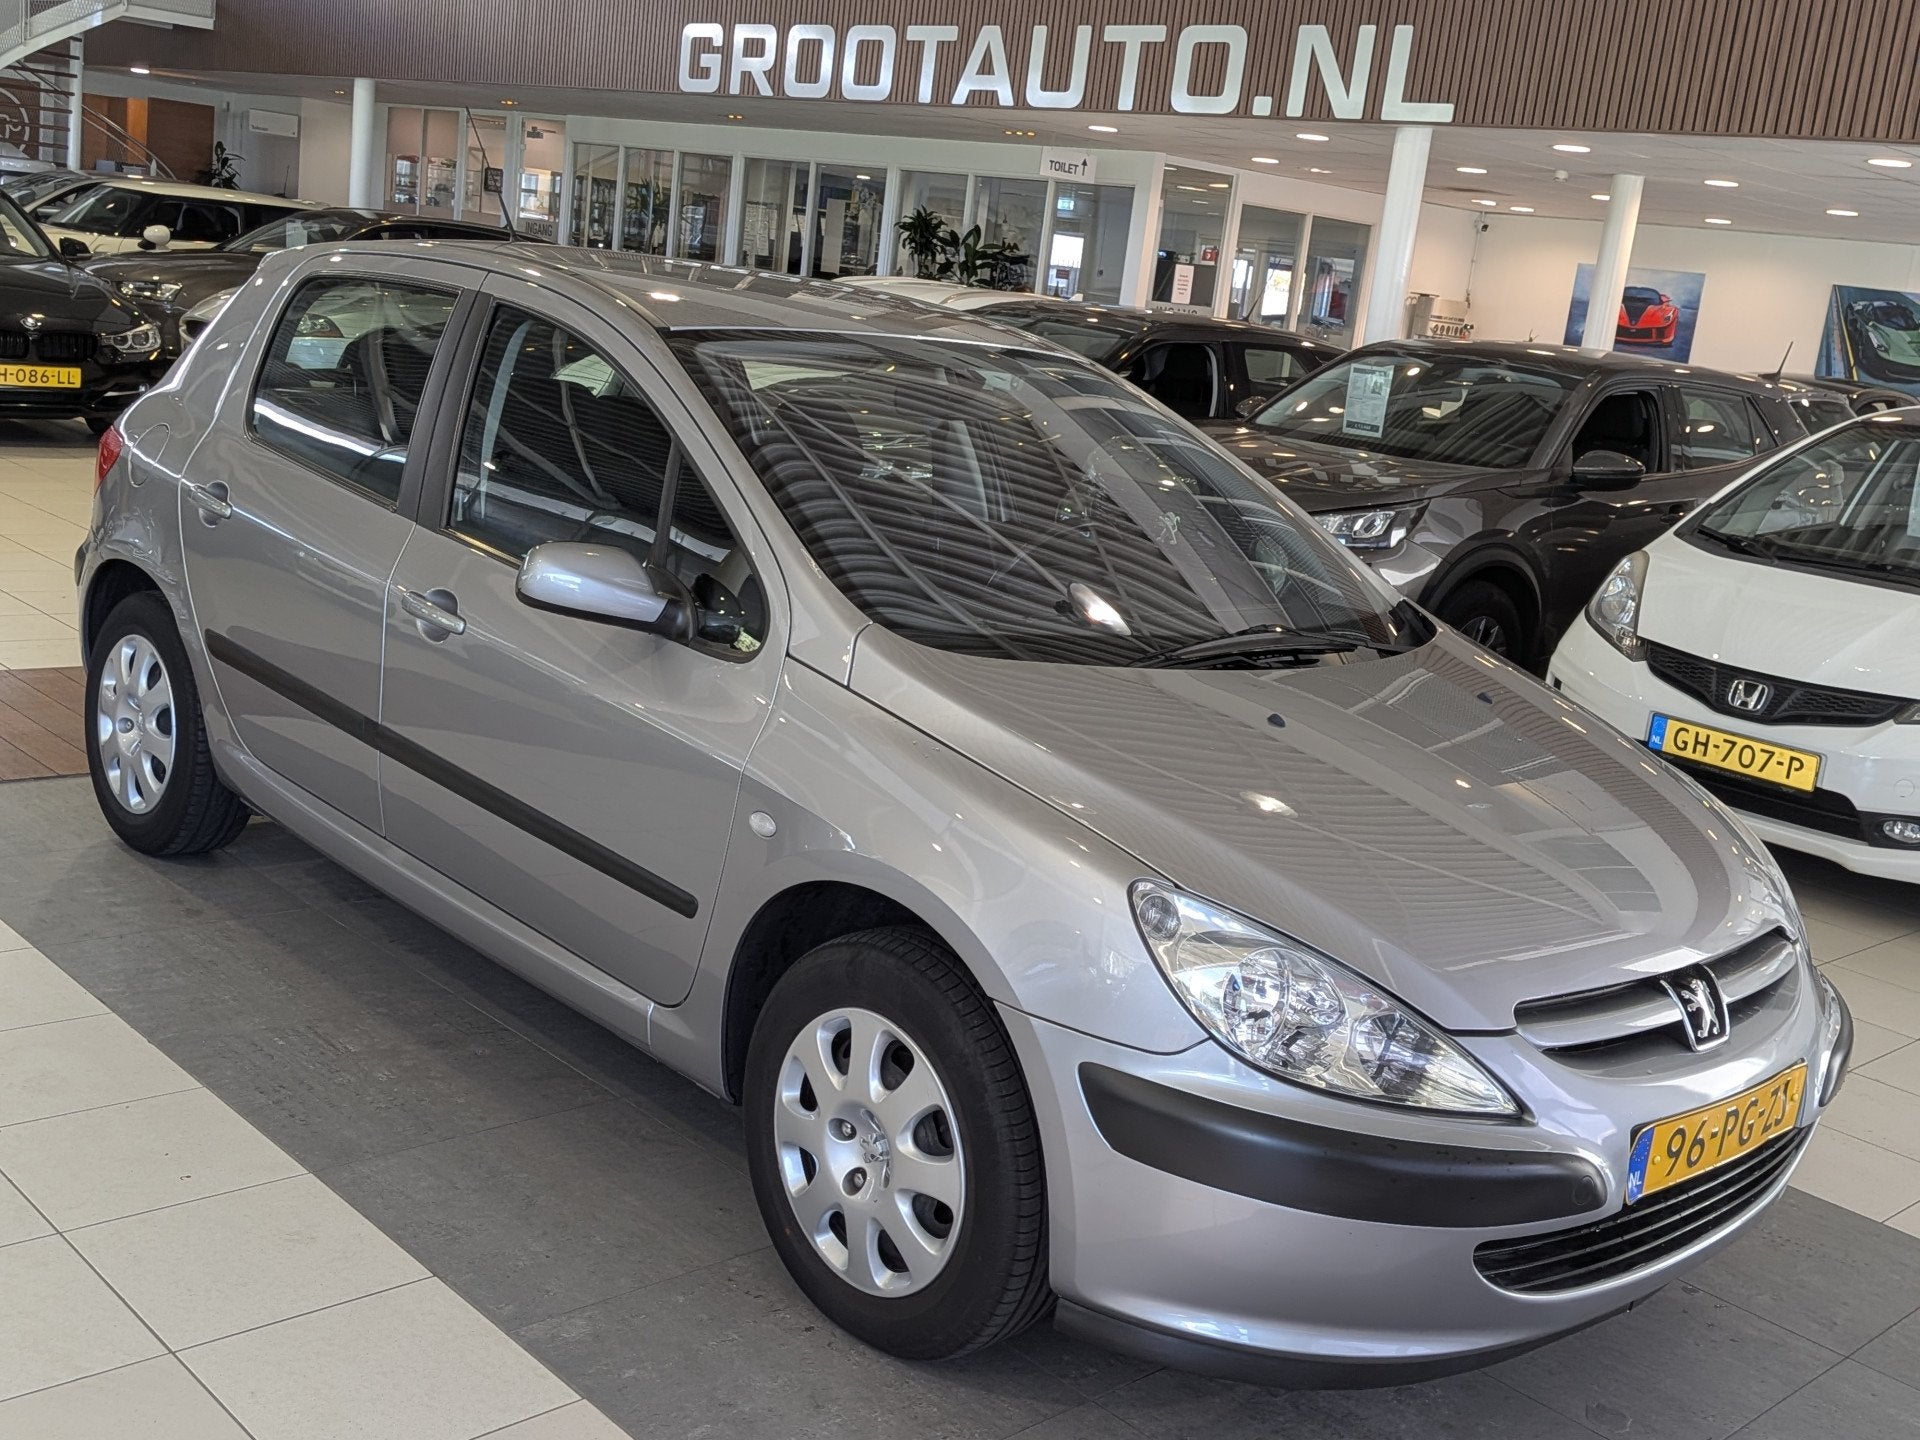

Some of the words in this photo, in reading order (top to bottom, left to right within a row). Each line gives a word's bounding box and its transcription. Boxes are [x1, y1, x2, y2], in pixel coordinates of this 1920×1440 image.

[679, 23, 1455, 123] GROOTAUTO.NL
[1049, 160, 1079, 175] TOILET
[525, 222, 553, 237] INGANG
[1651, 735, 1662, 745] NL
[1673, 727, 1805, 780] GH-707-P
[1665, 1077, 1792, 1177] 96-PG-ZJ
[1628, 1171, 1642, 1189] NL
